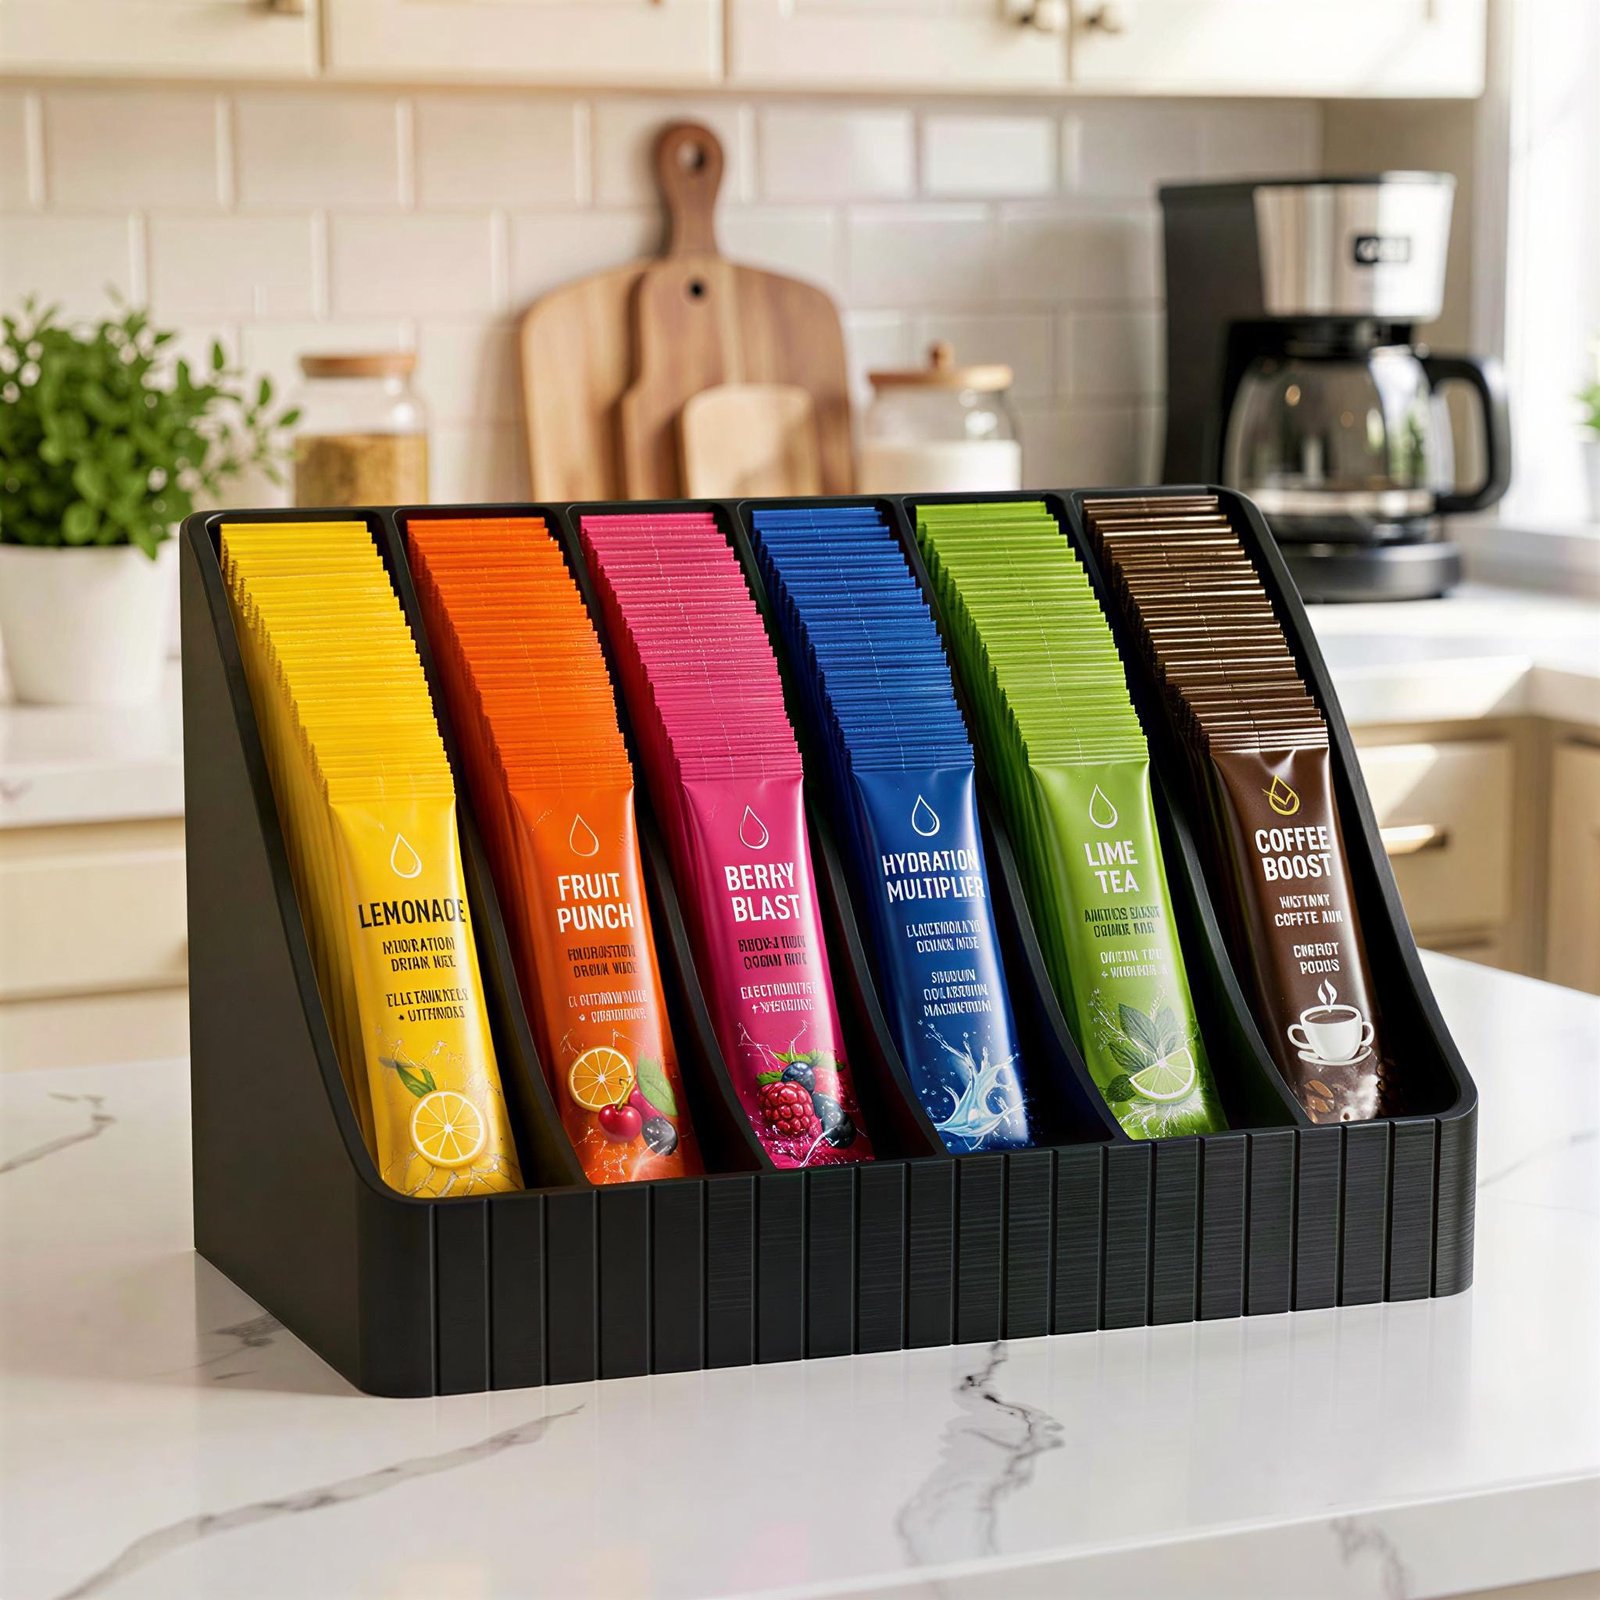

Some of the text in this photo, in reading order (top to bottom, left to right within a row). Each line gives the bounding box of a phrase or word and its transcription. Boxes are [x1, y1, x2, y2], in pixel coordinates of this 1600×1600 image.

[1084, 840, 1138, 867] LIME
[1255, 826, 1331, 854] COFFEE
[882, 848, 981, 876] HYDRATION
[1262, 853, 1331, 881] BOOST
[557, 872, 620, 902] FRUIT
[886, 876, 985, 903] MULTIPLIER
[1094, 870, 1139, 894] TEA
[358, 898, 466, 929] LEMONADE
[557, 902, 635, 933] PUNCH
[731, 894, 800, 923] BLAST
